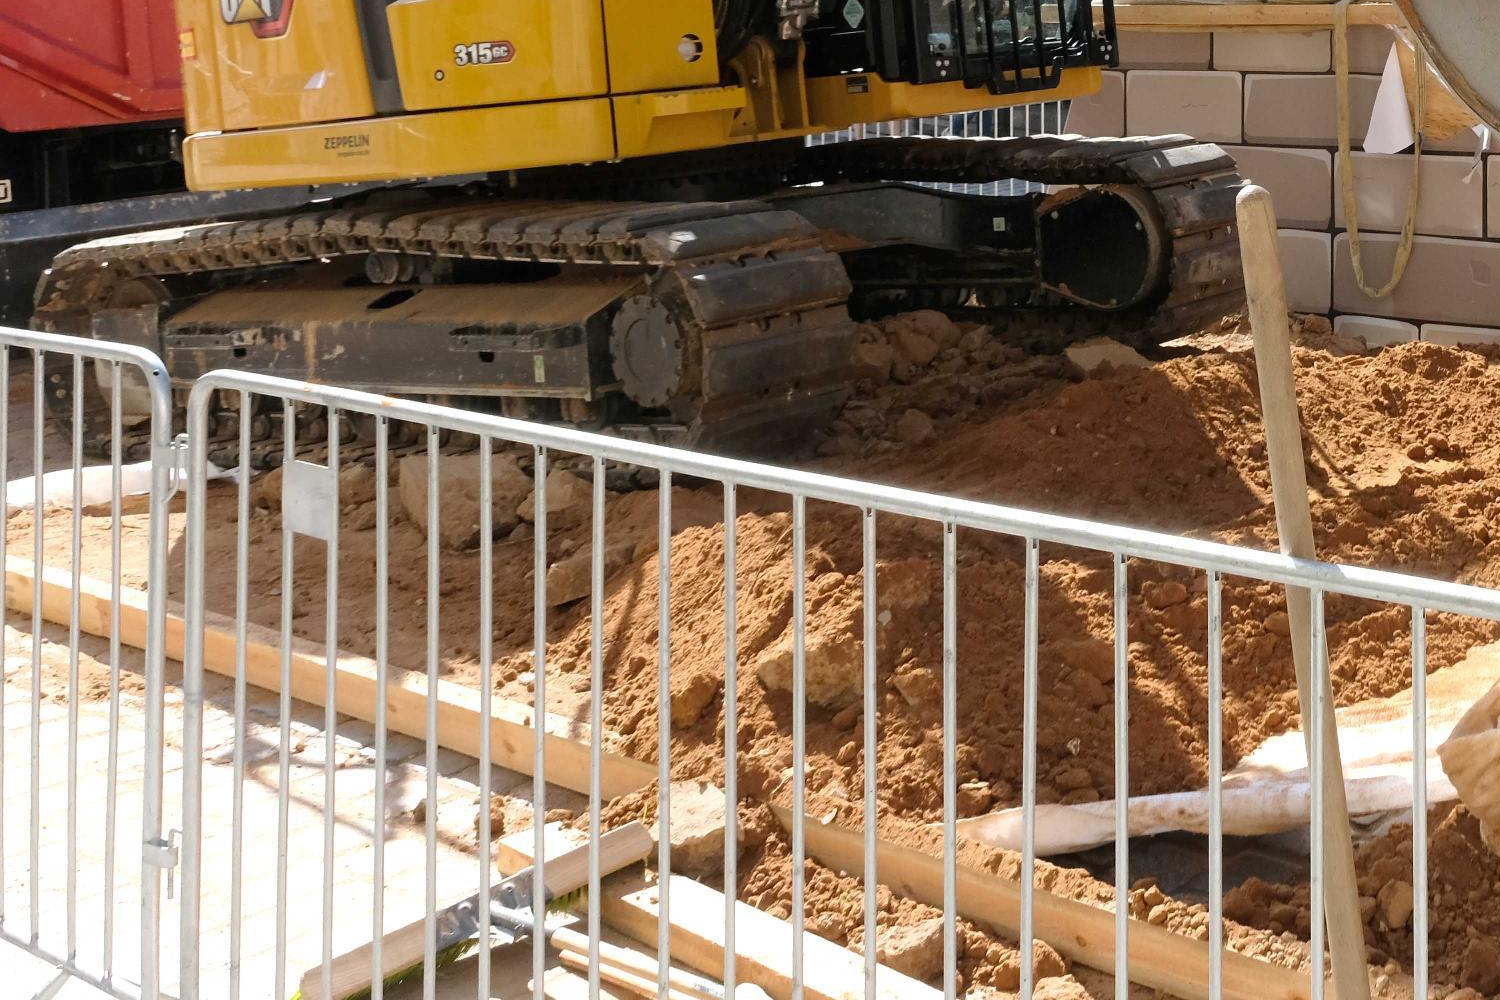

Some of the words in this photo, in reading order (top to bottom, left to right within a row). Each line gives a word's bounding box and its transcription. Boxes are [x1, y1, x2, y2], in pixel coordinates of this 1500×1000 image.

[454, 43, 493, 66] 315
[492, 46, 508, 58] GC
[324, 134, 370, 150] ZEPPELIN
